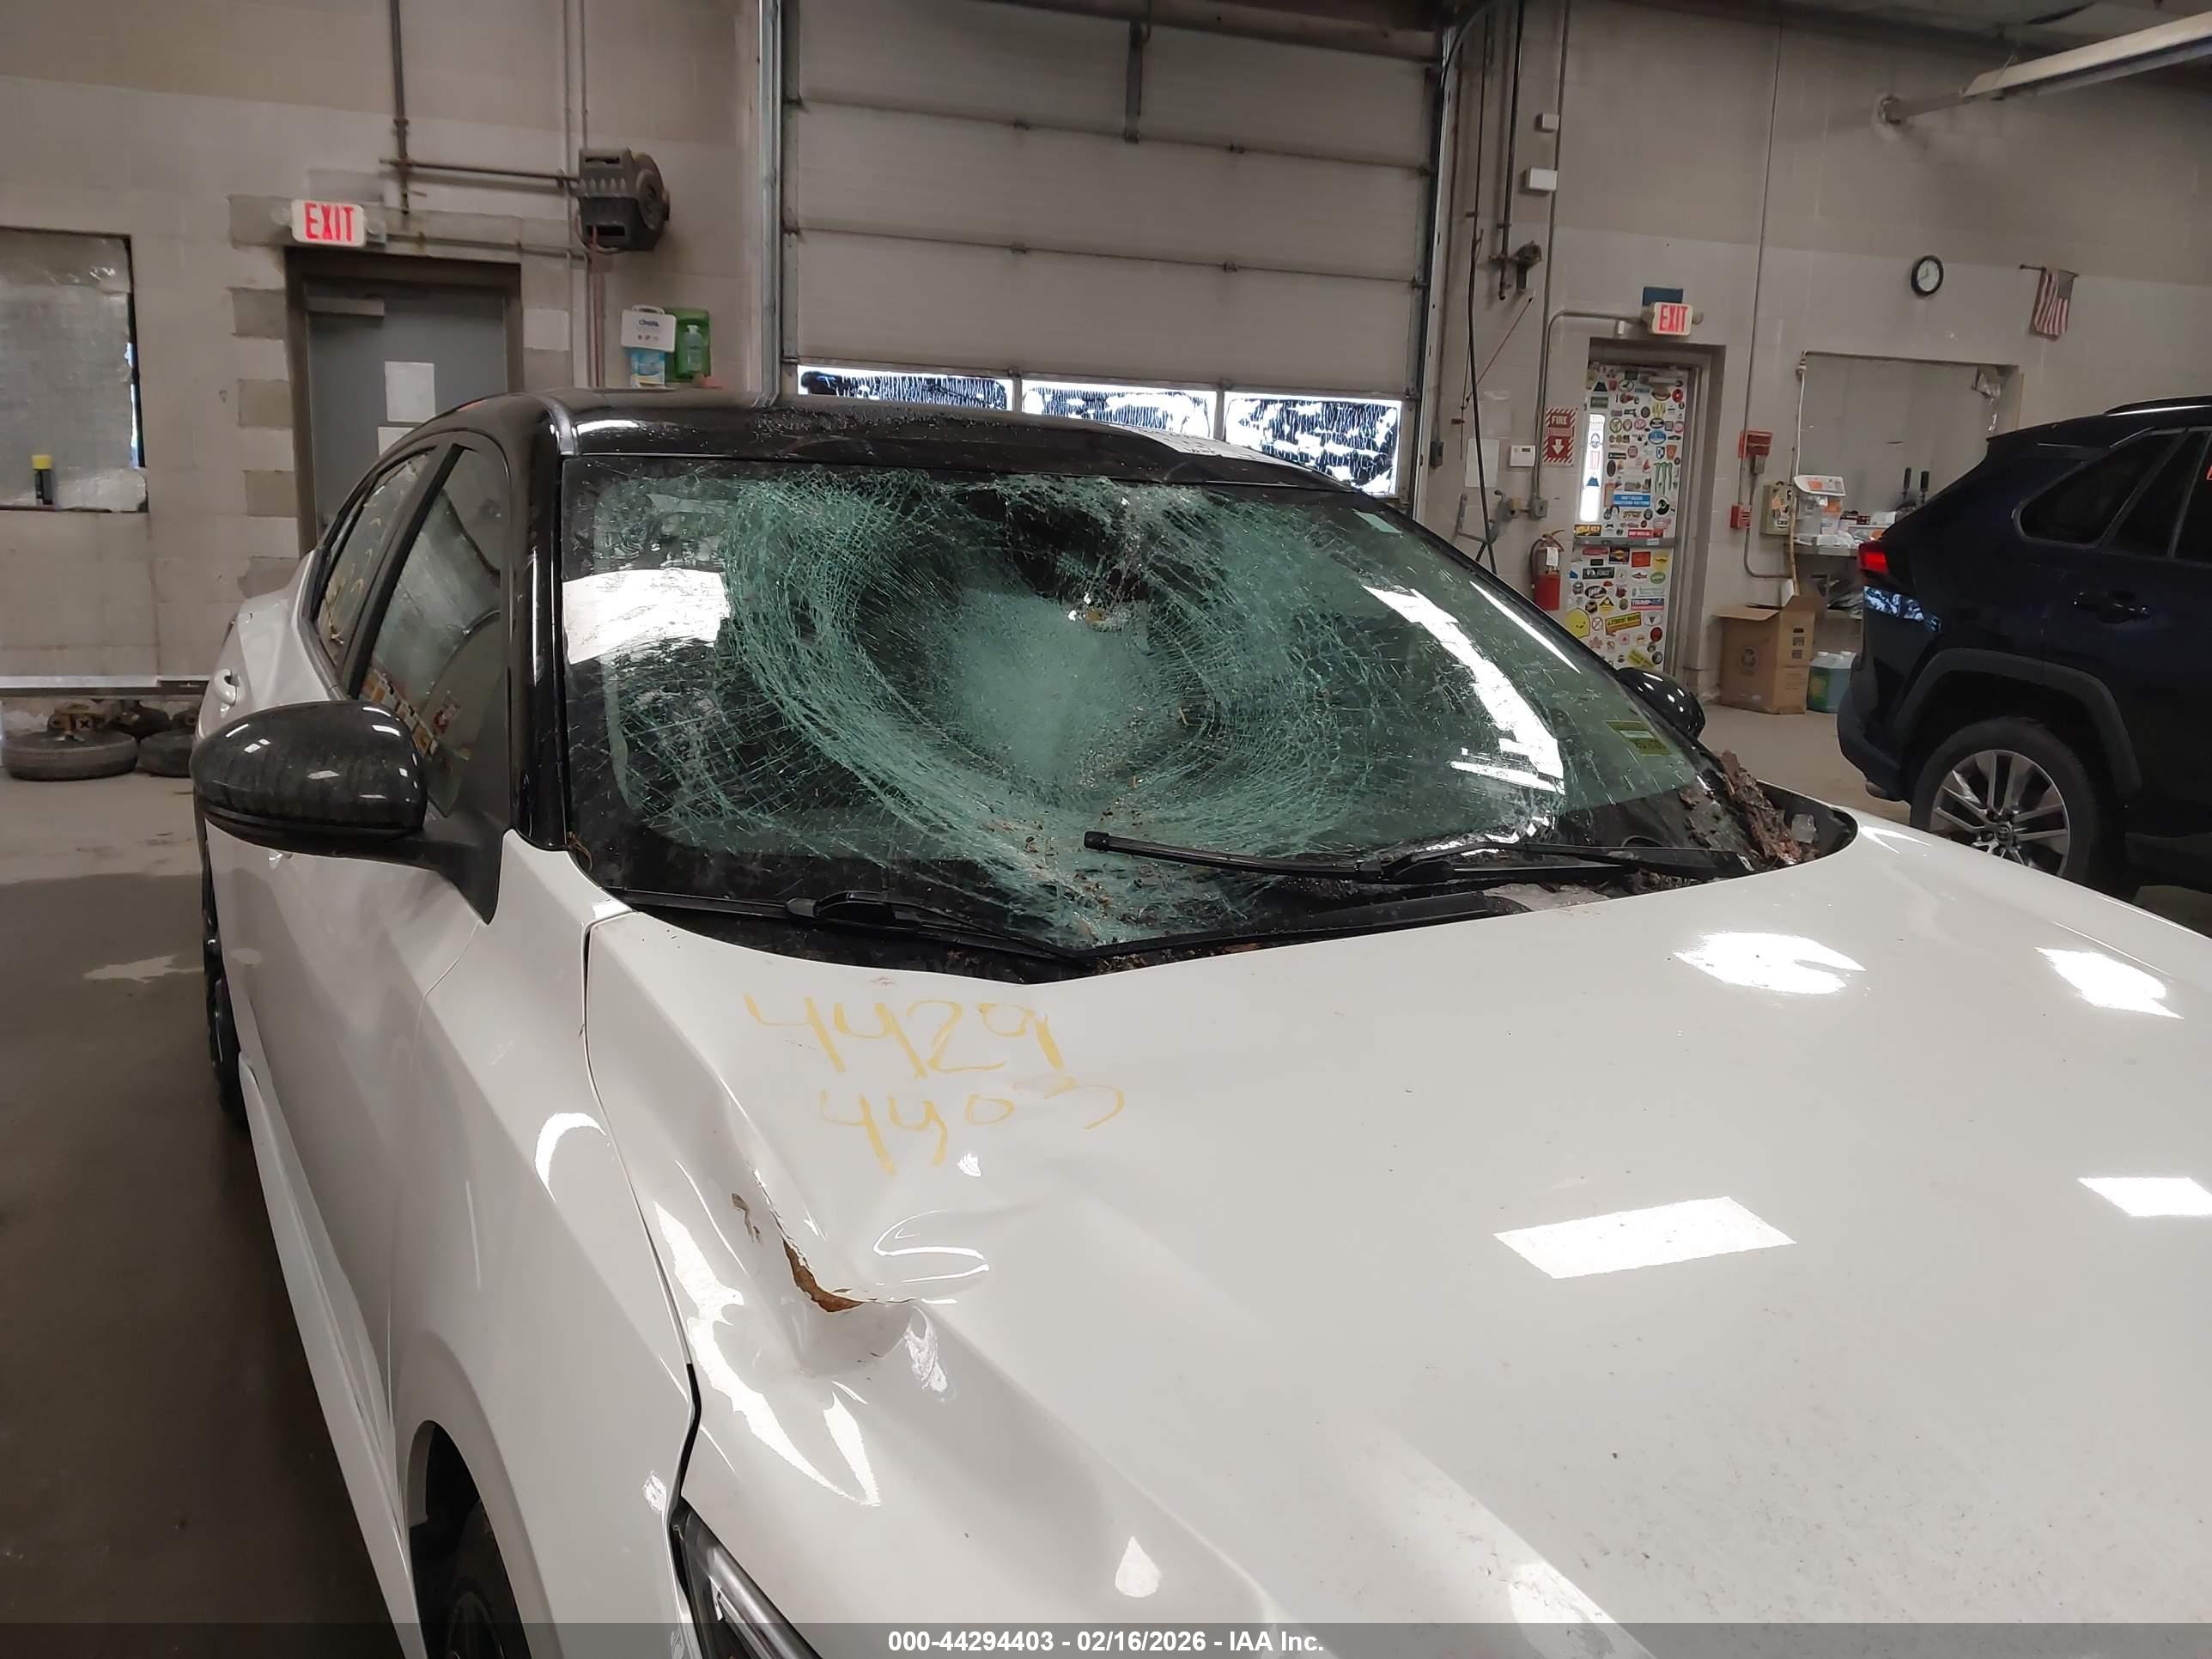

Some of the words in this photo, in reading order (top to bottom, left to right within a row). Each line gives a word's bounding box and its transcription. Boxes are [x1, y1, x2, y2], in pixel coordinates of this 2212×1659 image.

[304, 201, 355, 242] EXIT
[1659, 305, 1688, 333] EXIT
[1552, 415, 1568, 426] FIRE
[744, 994, 1066, 1079] 4429
[819, 1075, 1125, 1175] 4403
